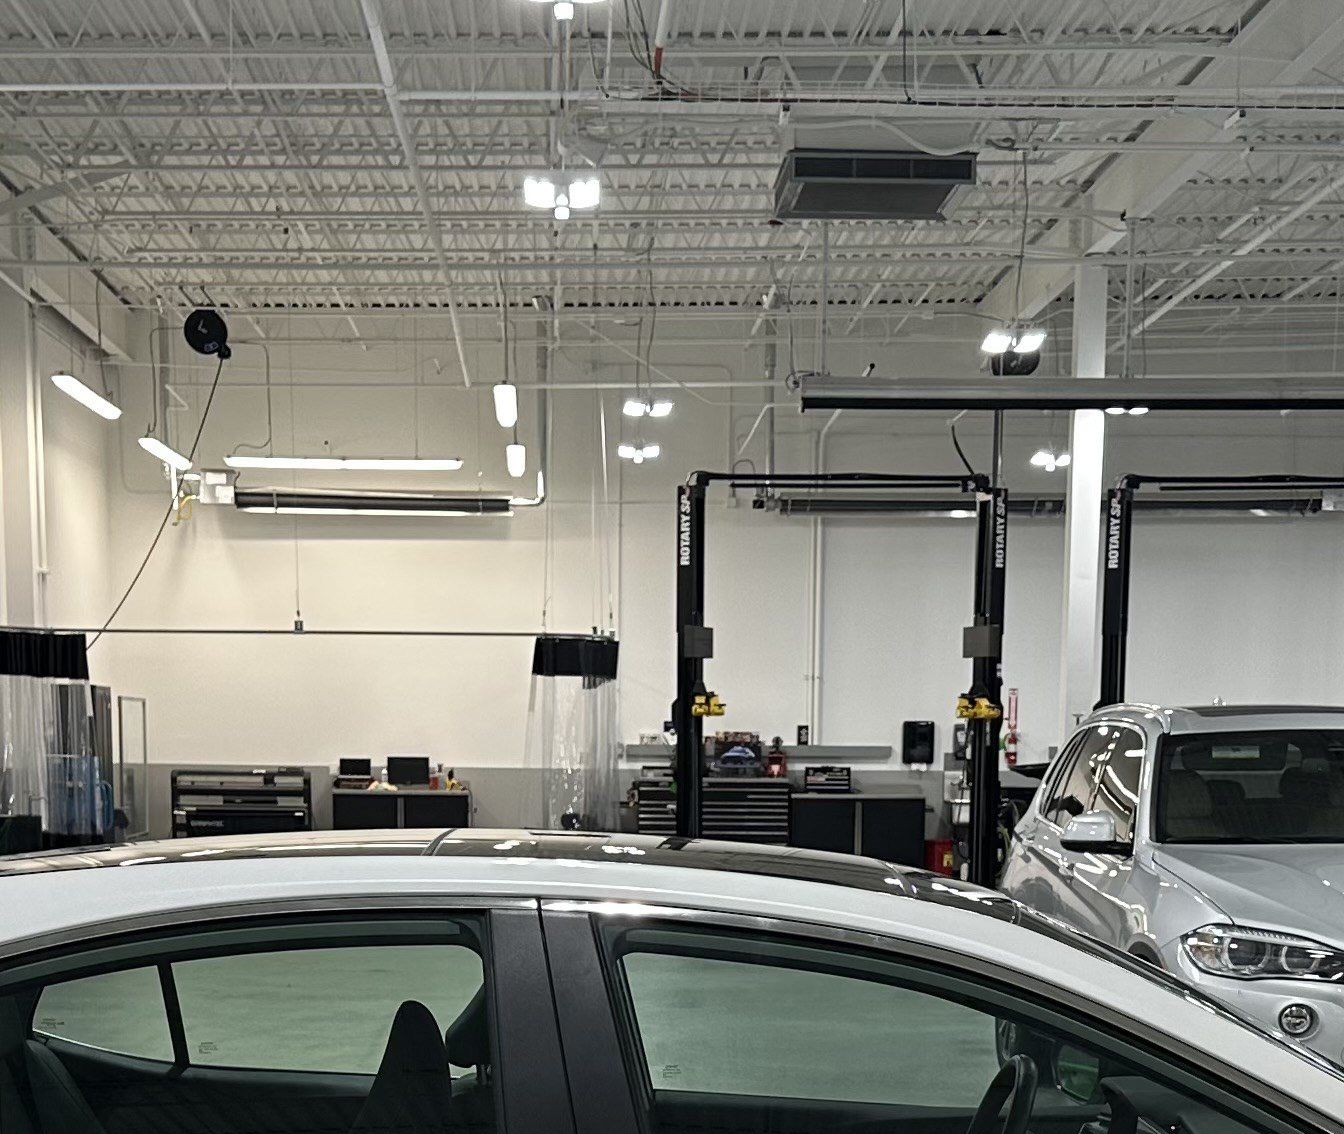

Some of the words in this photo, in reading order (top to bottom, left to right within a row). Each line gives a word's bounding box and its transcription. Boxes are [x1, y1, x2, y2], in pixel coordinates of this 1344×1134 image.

[680, 514, 691, 566] ROTARY
[995, 517, 1005, 568] ROTARY
[1108, 517, 1120, 569] ROTARY
